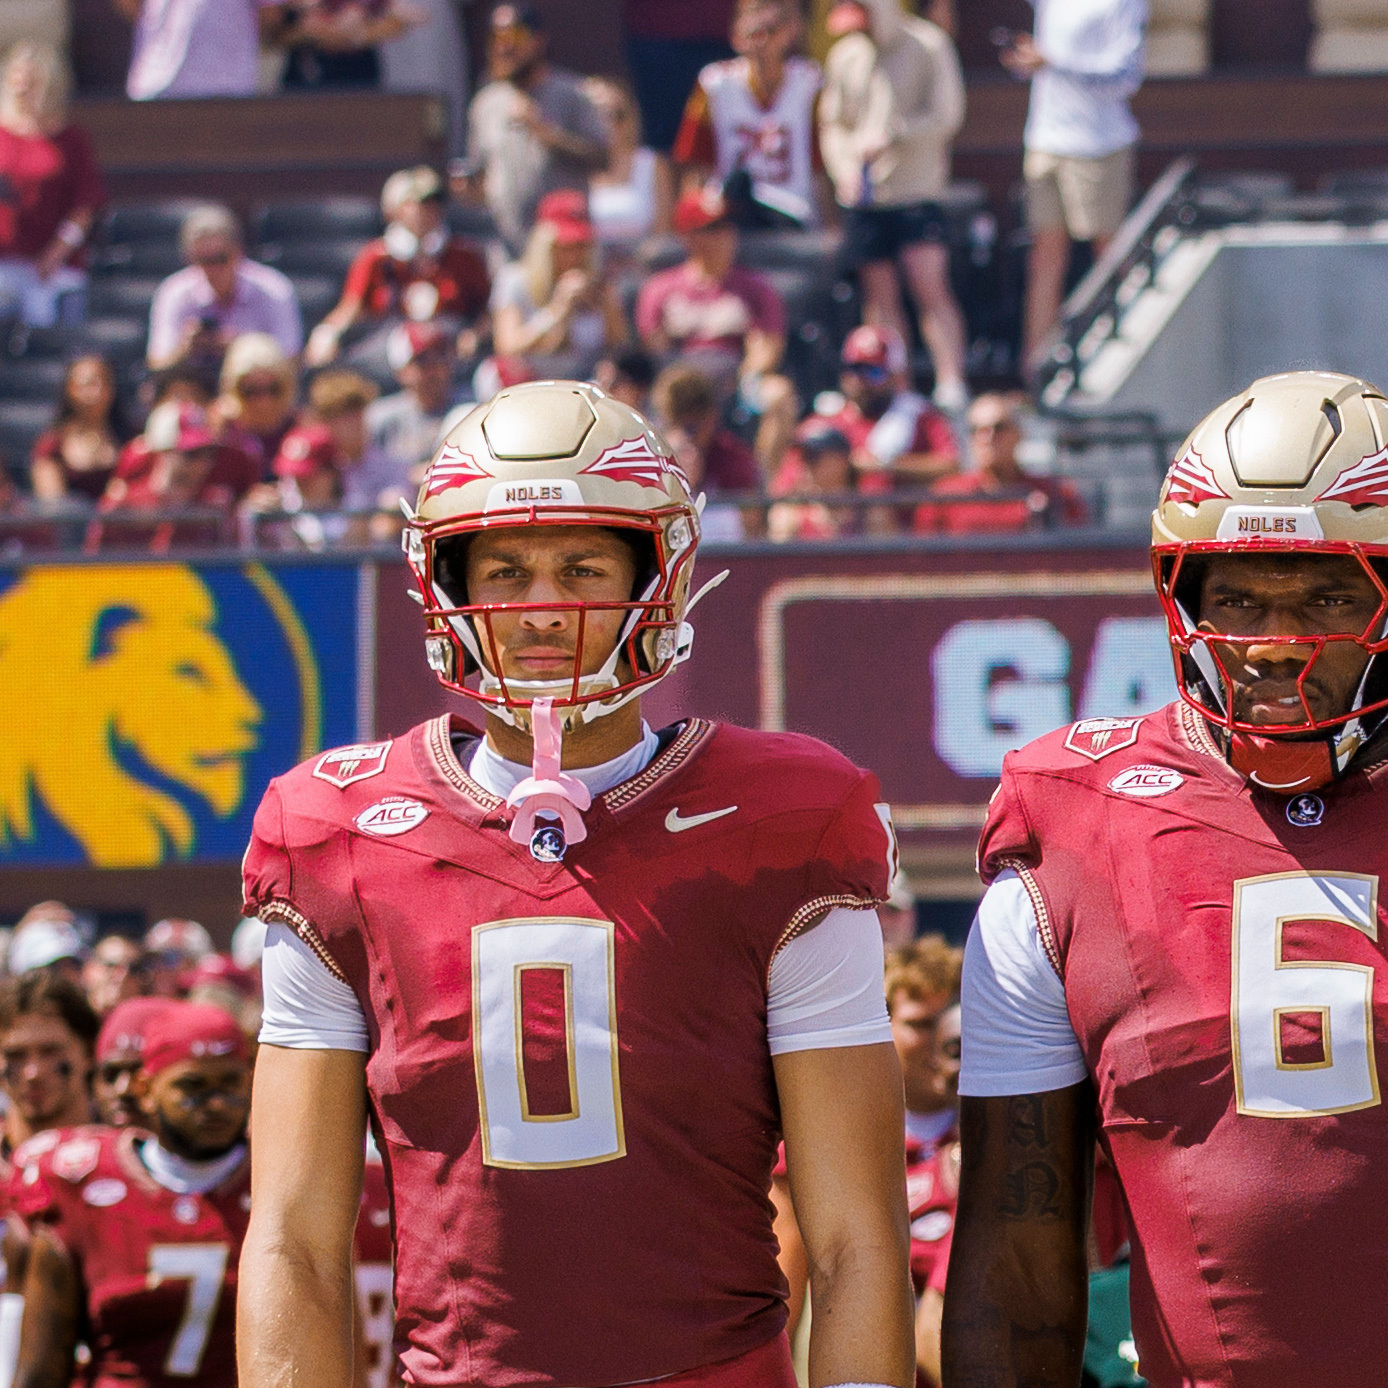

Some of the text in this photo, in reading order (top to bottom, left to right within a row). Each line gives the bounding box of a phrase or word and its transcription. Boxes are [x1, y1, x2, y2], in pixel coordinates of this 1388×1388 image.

[505, 487, 563, 502] NOLES
[1237, 516, 1297, 533] NOLES
[1121, 773, 1175, 786] ACC
[366, 804, 420, 823] ACC
[1230, 870, 1382, 1119] 6
[471, 916, 627, 1171] 0
[147, 1243, 230, 1378] 7
